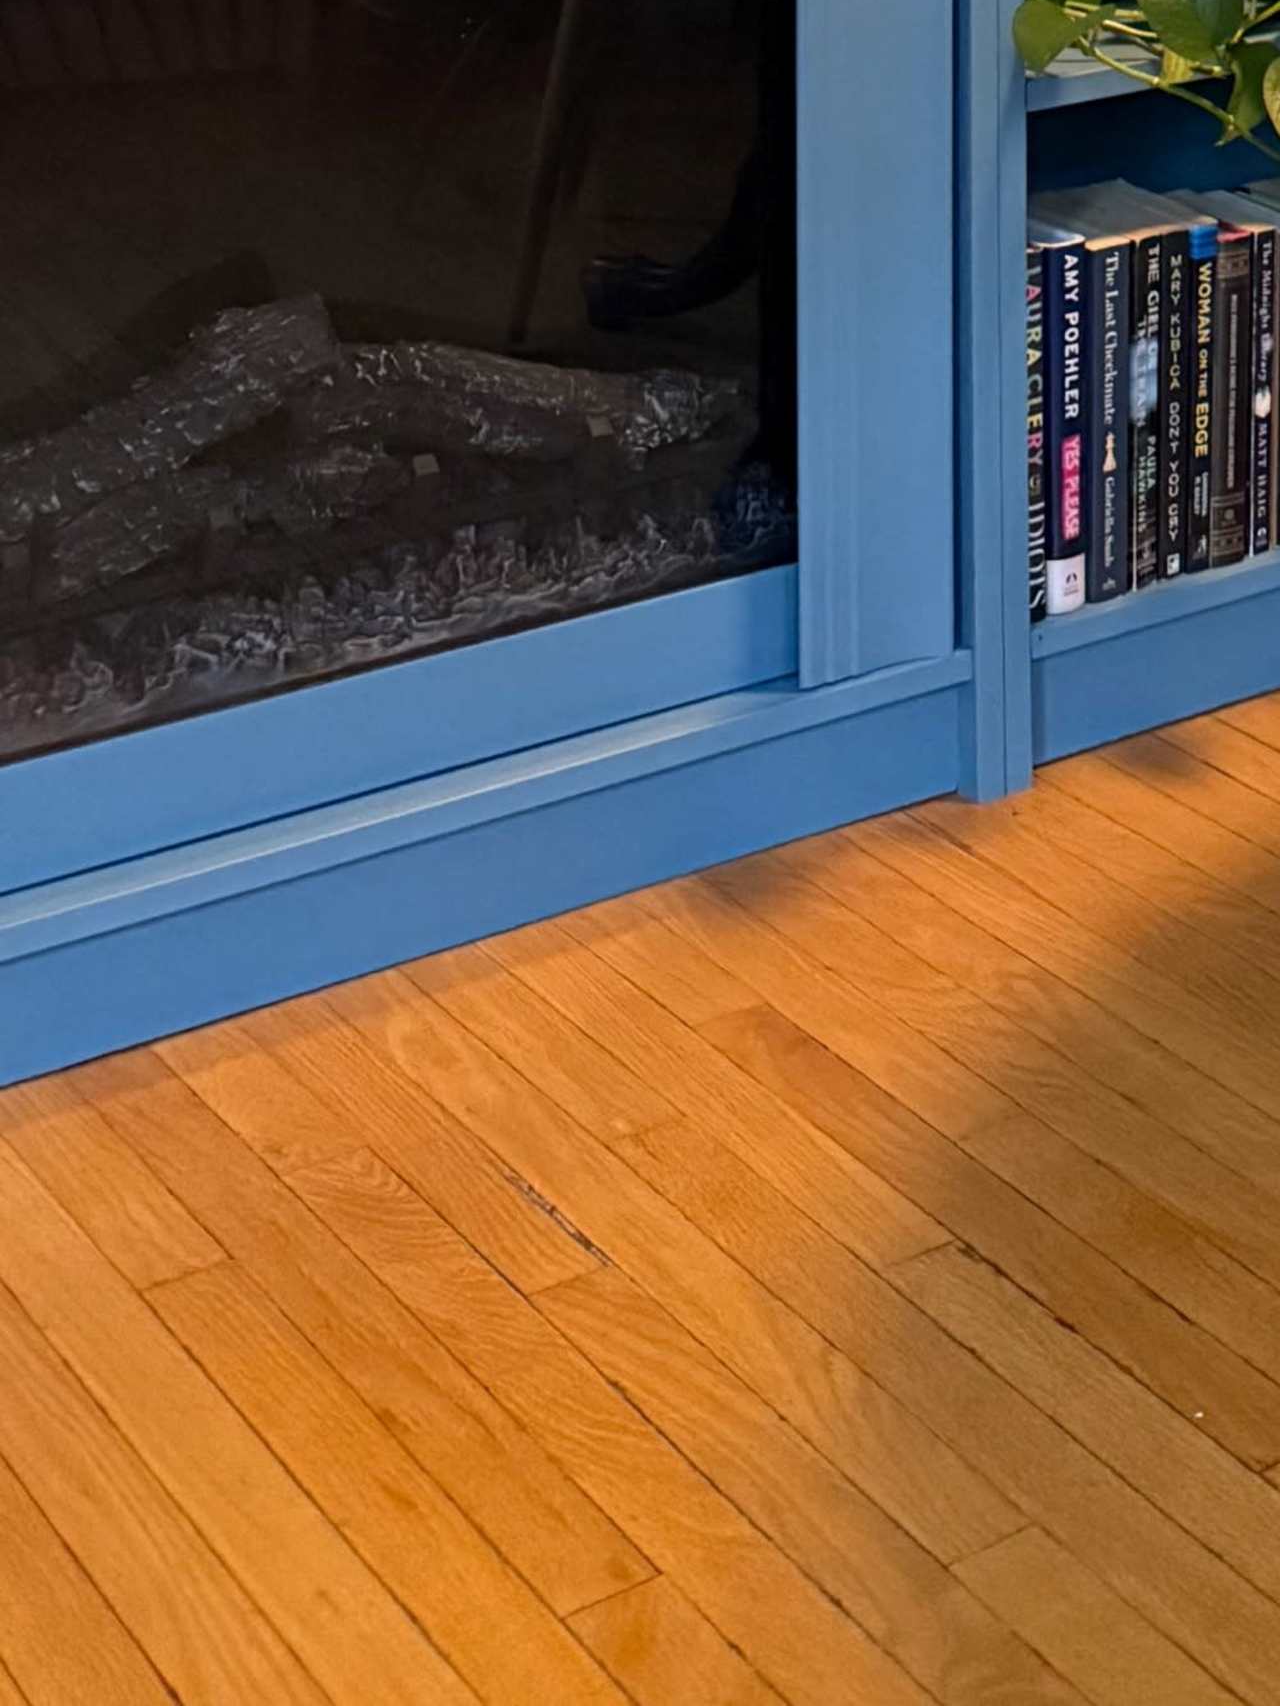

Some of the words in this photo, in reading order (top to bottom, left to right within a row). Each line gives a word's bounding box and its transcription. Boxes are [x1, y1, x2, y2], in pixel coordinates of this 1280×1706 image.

[1104, 252, 1120, 287] The
[1146, 243, 1160, 283] THE
[1261, 241, 1273, 265] The
[1064, 254, 1079, 302] AMY
[1168, 254, 1183, 305] MARY
[1259, 268, 1273, 329] Midnight
[1104, 290, 1119, 327] Last
[1146, 290, 1160, 338] GIRL
[1197, 261, 1213, 344] WOMAN
[1064, 312, 1080, 419] POEHLER
[1168, 314, 1183, 391] KUBICA
[1199, 348, 1209, 368] ON
[1103, 331, 1119, 425] Checkmate
[1198, 371, 1209, 397] THE
[1193, 401, 1209, 459] EDGE
[1257, 422, 1268, 465] MATT
[1063, 438, 1080, 471] YES
[1145, 435, 1158, 490] PAULA
[1135, 455, 1149, 533] HAWKINS
[1167, 460, 1181, 498] YOU
[1256, 473, 1268, 518] HAIG
[1063, 474, 1081, 540] PLEASE
[1166, 503, 1181, 542] CRY
